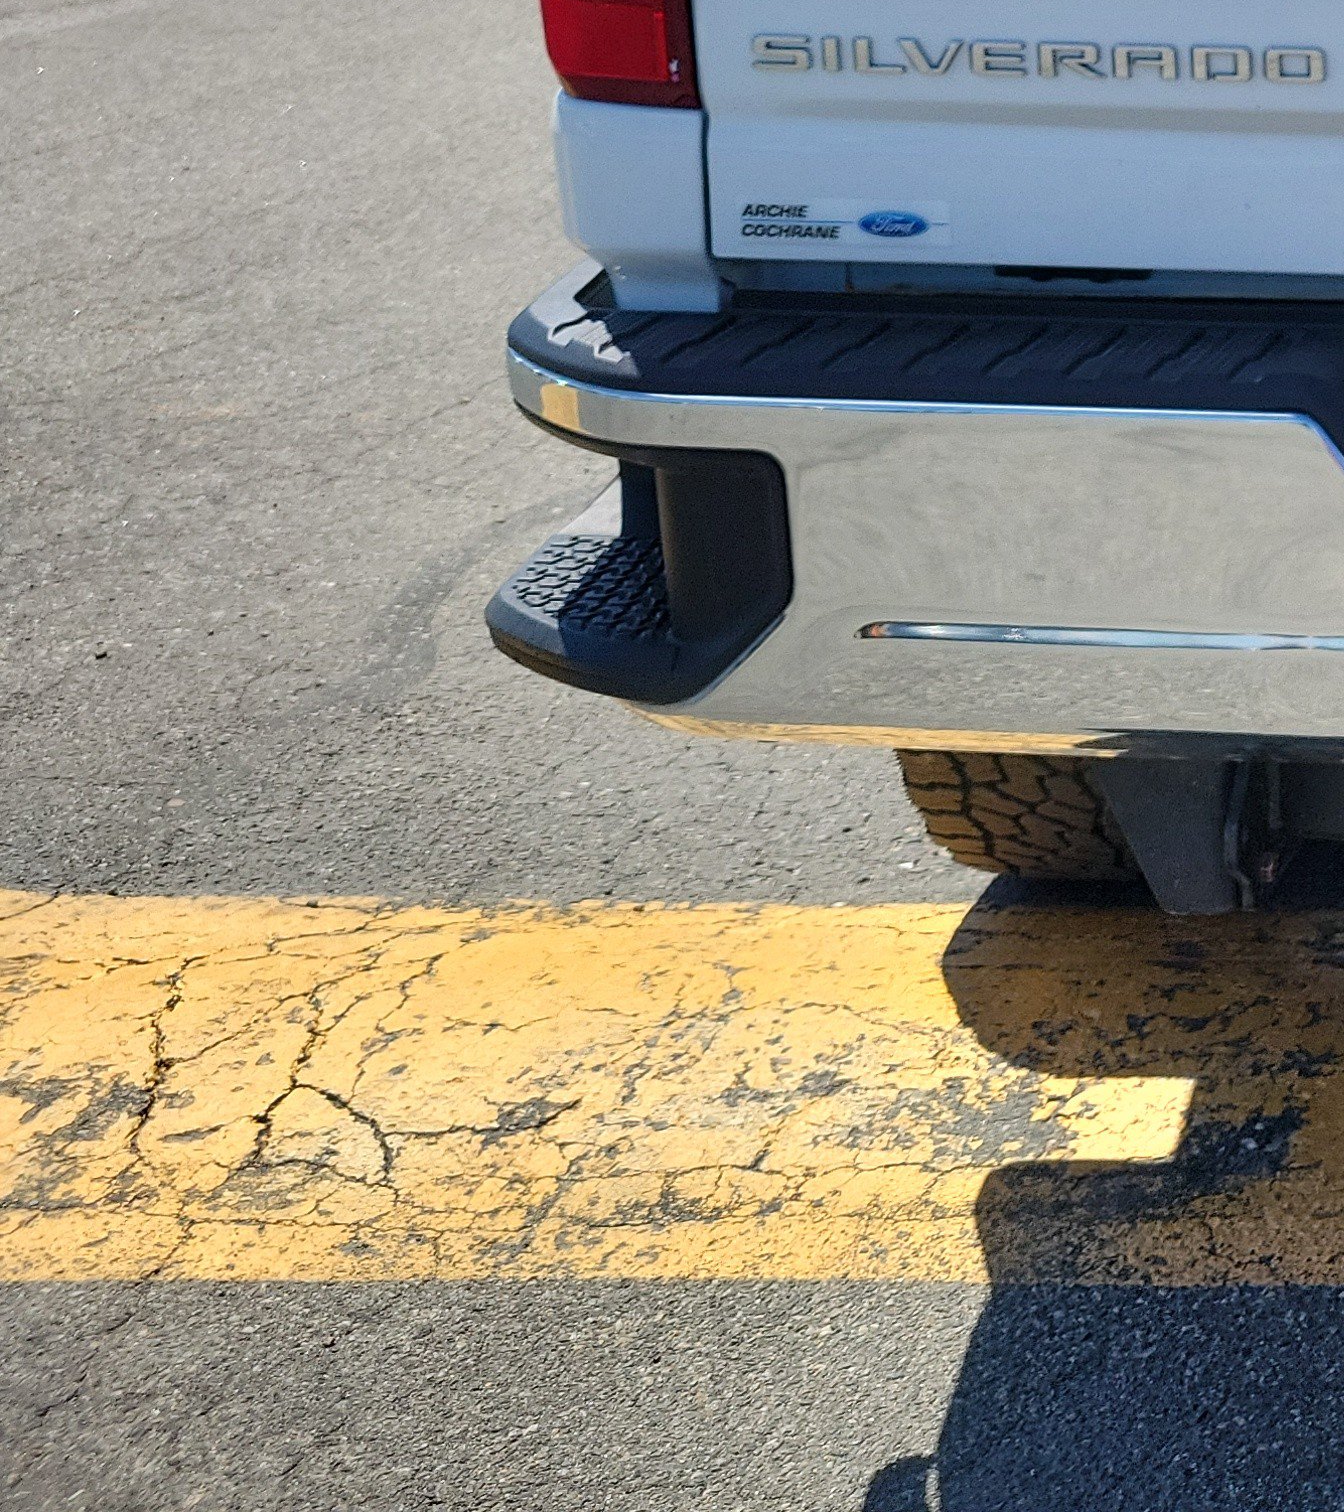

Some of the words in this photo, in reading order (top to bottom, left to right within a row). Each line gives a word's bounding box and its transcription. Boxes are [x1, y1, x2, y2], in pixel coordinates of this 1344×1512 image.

[750, 32, 1329, 85] SILVERADO
[741, 203, 809, 219] ARCHIE
[741, 223, 841, 239] COCHRANE
[871, 215, 918, 234] Ford
